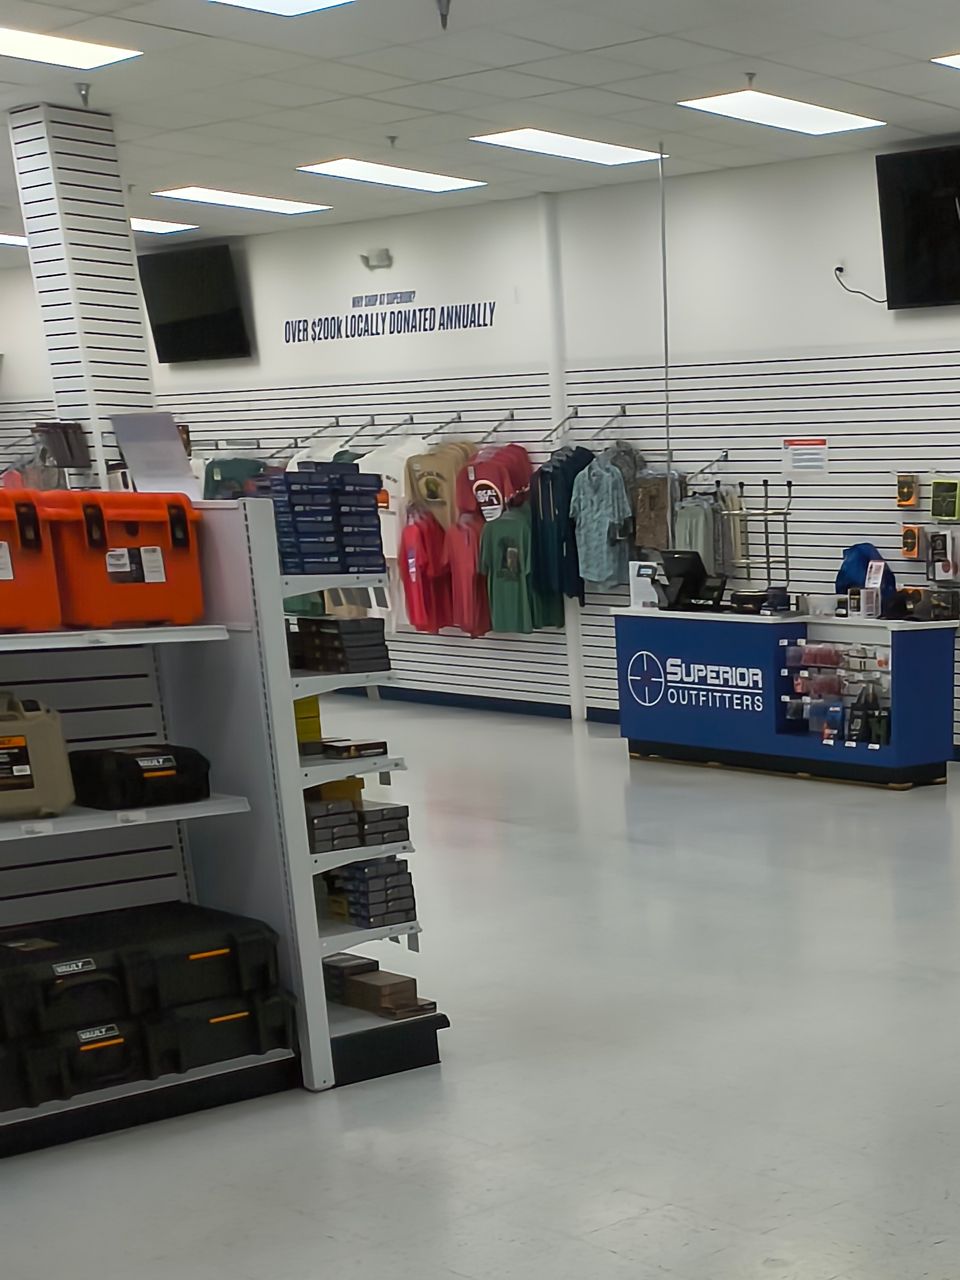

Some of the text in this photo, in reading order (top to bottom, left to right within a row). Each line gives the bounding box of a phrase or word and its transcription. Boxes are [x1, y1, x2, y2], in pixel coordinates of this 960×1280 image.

[284, 302, 496, 343] OVER $200k LOCALLY DONATED ANNUALLY
[666, 658, 763, 688] SUPERIOR
[667, 688, 764, 712] OUTFITTERS
